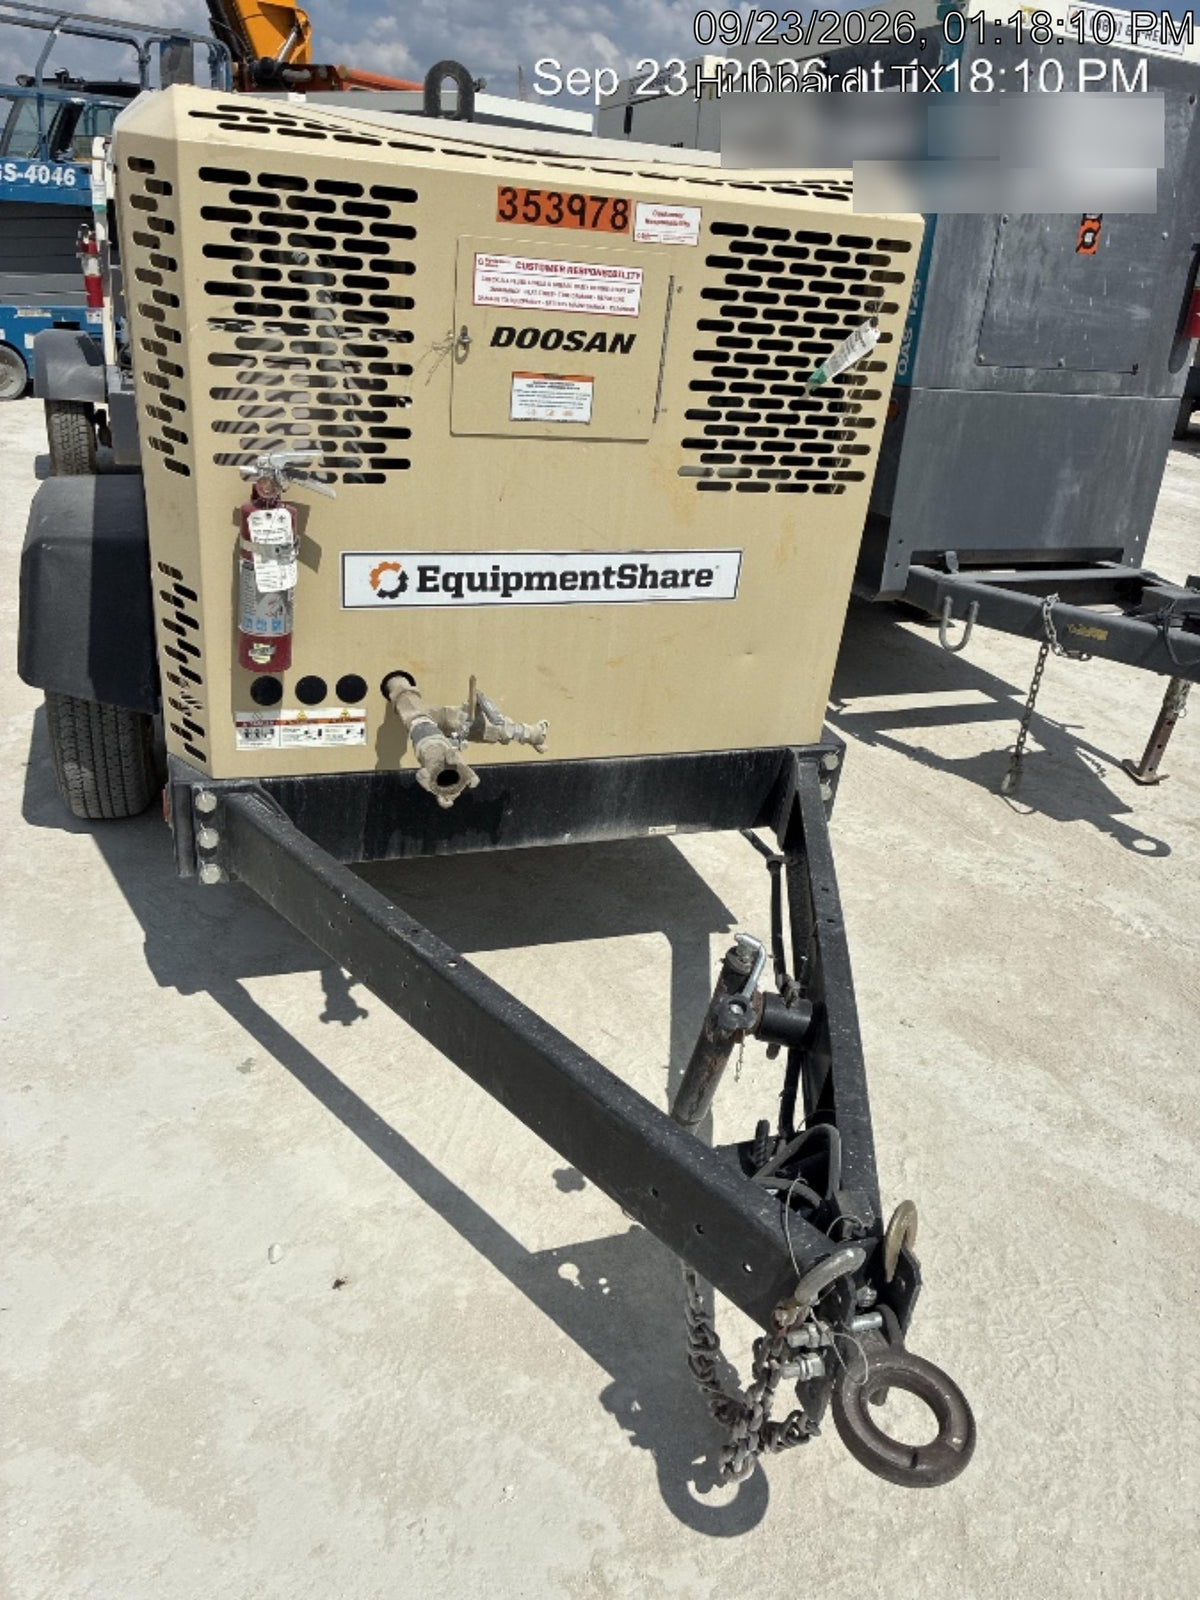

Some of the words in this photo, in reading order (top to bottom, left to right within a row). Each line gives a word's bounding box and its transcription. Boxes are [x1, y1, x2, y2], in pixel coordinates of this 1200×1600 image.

[0, 163, 76, 187] S-4046
[499, 186, 630, 231] 353978
[515, 260, 565, 274] CUSTOMER
[566, 266, 641, 280] RESPONSIBILITY
[490, 326, 637, 354] DOOSAN
[416, 563, 714, 598] EquipmentShare
